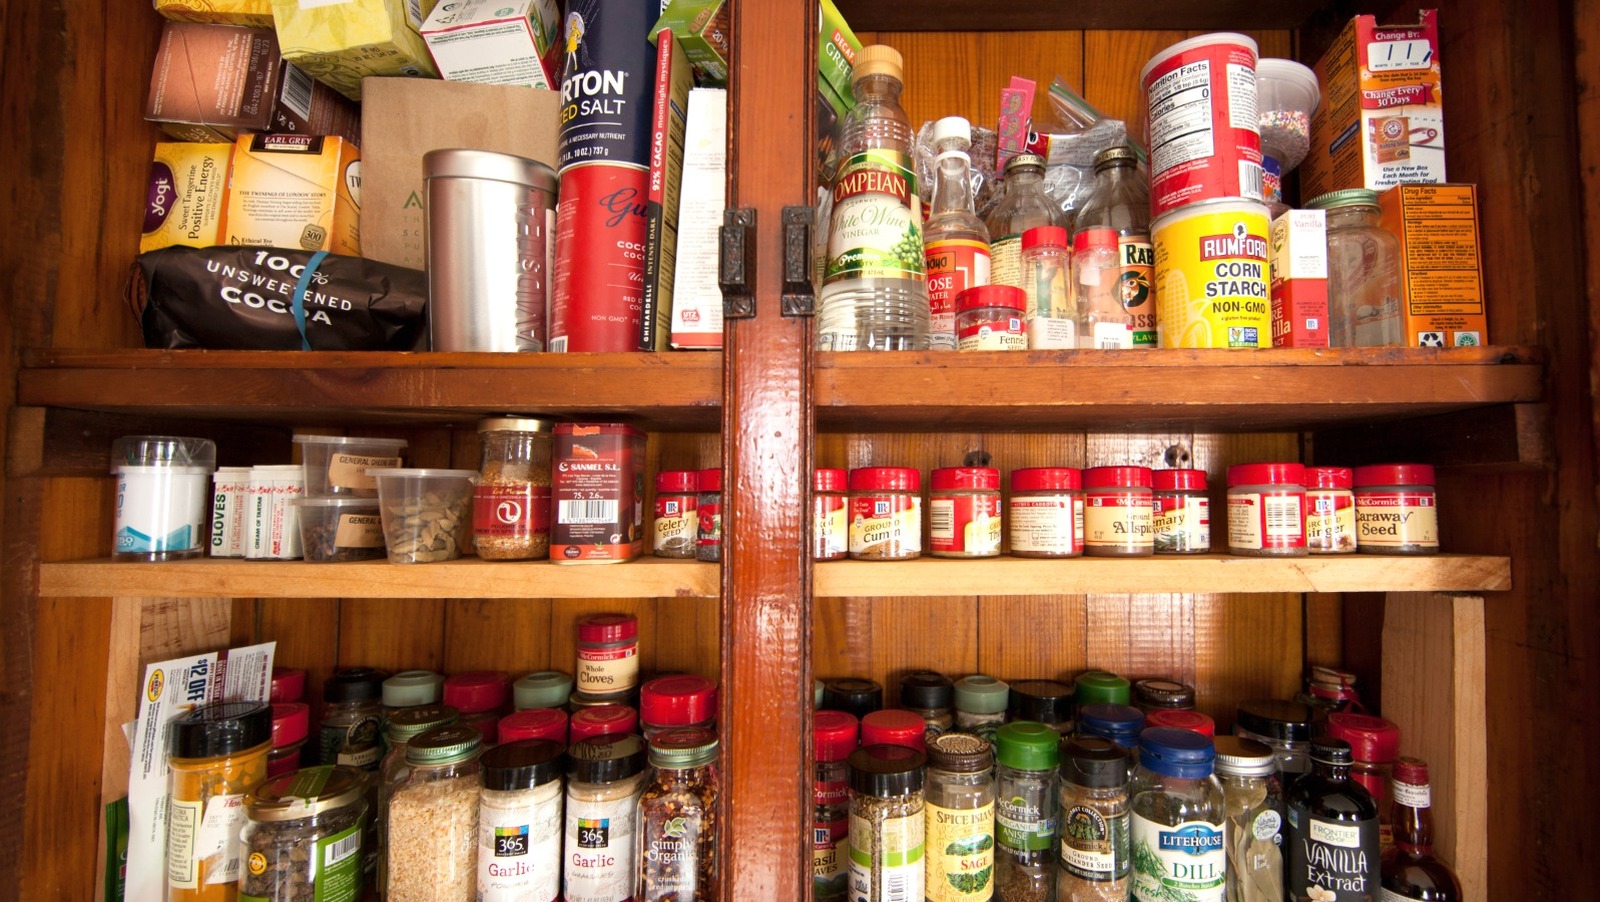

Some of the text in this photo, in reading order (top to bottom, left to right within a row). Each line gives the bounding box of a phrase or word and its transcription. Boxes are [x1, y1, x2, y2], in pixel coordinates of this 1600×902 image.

[1375, 32, 1406, 40] Change
[834, 32, 854, 59] DECAF
[1180, 63, 1208, 76] Facts
[1202, 88, 1209, 98] 0
[1364, 87, 1421, 100] Change Every
[580, 98, 626, 116] SALT
[657, 84, 666, 128] moonlight
[1378, 96, 1410, 106] 30 Days
[264, 136, 312, 146] EARL GREY
[598, 132, 626, 140] NUTRIENT
[592, 146, 604, 155] 737
[653, 131, 662, 168] CACAO
[652, 170, 661, 191] 92%
[152, 178, 169, 218] Yogi
[178, 164, 198, 231] Sweet Tangerine
[188, 156, 216, 240] Positive Energy
[1404, 188, 1420, 196] Drug
[860, 204, 906, 230] Wine
[1294, 220, 1322, 228] Vanilla
[306, 230, 322, 241] 300
[842, 228, 880, 239] VINEGAR
[1204, 238, 1267, 258] RUMFORD
[647, 243, 656, 275] INTENSE
[838, 252, 880, 266] Premium
[1215, 263, 1262, 278] CORN
[1206, 281, 1268, 298] STARCH
[643, 284, 653, 342] GHIRARDELLI
[1212, 301, 1266, 314] NON-GMO
[1000, 336, 1026, 345] Fennel
[339, 456, 370, 466] GENERAL
[570, 463, 603, 471] SANMEL
[574, 492, 600, 500] 75 2.6
[212, 494, 226, 547] CLOVES
[348, 516, 377, 524] GENERAL
[658, 518, 689, 532] Celery
[864, 520, 900, 532] GROUND
[662, 528, 681, 538] SEED
[1362, 522, 1398, 536] Seed
[580, 652, 615, 660] McCormick
[187, 658, 208, 702] $12 OFF
[580, 672, 614, 684] Cloves
[936, 811, 969, 824] SPICE
[1082, 806, 1105, 832] COLLECTION
[582, 828, 604, 844] 365
[1003, 828, 1027, 840] ANISE
[1313, 824, 1356, 839] FRONTIER
[499, 837, 524, 852] 365
[651, 838, 694, 853] Simply
[1162, 835, 1222, 846] LITEHOUSE
[572, 853, 614, 868] Garlic
[814, 851, 836, 867] asil
[1072, 850, 1098, 861] GROUND
[1302, 838, 1369, 874] VANILLA
[488, 862, 534, 877] Garlic
[960, 856, 988, 871] SAGE
[1172, 862, 1217, 880] DILL
[1307, 864, 1367, 892] Extract
[1134, 880, 1162, 898] Fresh
